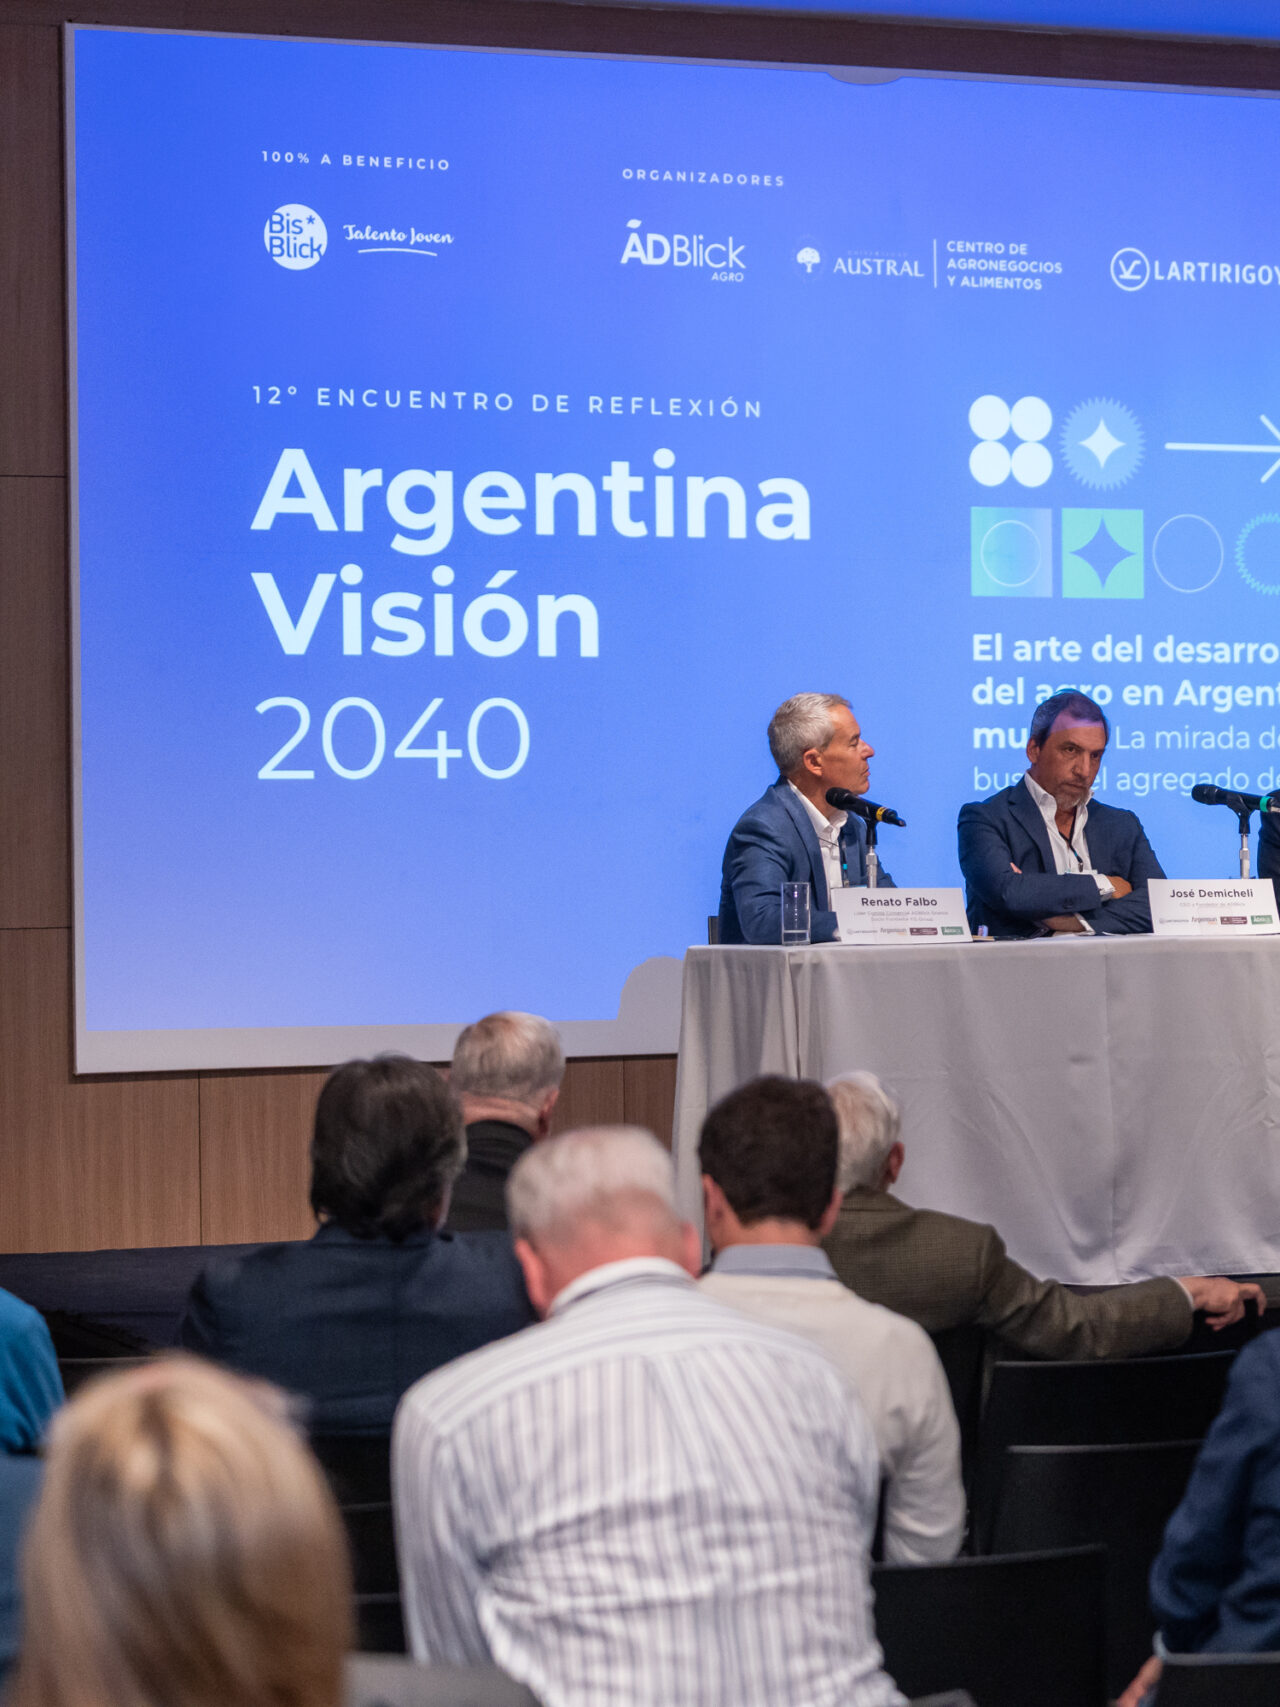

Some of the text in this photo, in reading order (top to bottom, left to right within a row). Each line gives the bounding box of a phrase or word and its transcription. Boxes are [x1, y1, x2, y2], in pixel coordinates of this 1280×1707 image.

[261, 150, 450, 171] 100% A BENEFICIO
[622, 168, 785, 187] ORGANIZADORES
[342, 224, 455, 246] Talento Joven
[269, 236, 322, 260] Blick
[946, 240, 1028, 256] CENTRO DE
[711, 271, 744, 283] AGRO
[833, 257, 925, 278] AUSTRAL
[946, 258, 1063, 274] AGRONEGOCIOS
[946, 275, 1042, 291] Y ALIMENTOS
[317, 387, 514, 412] ENCUENTRO
[532, 393, 570, 413] DE
[589, 396, 762, 419] REFLEXIÓN
[250, 447, 811, 556] Argentina
[251, 563, 600, 658] Visión
[972, 632, 1003, 662] El
[1013, 636, 1082, 663] arte
[1091, 633, 1143, 663] del
[971, 676, 1025, 706] del
[1035, 683, 1113, 706] aro
[1121, 683, 1165, 706] en
[254, 696, 531, 780] 2040
[1115, 725, 1145, 749] La
[1155, 724, 1250, 750] mirada
[1116, 766, 1250, 796] agregado
[861, 897, 938, 906] Renato Falbo
[1170, 888, 1254, 898] José Demicheli
